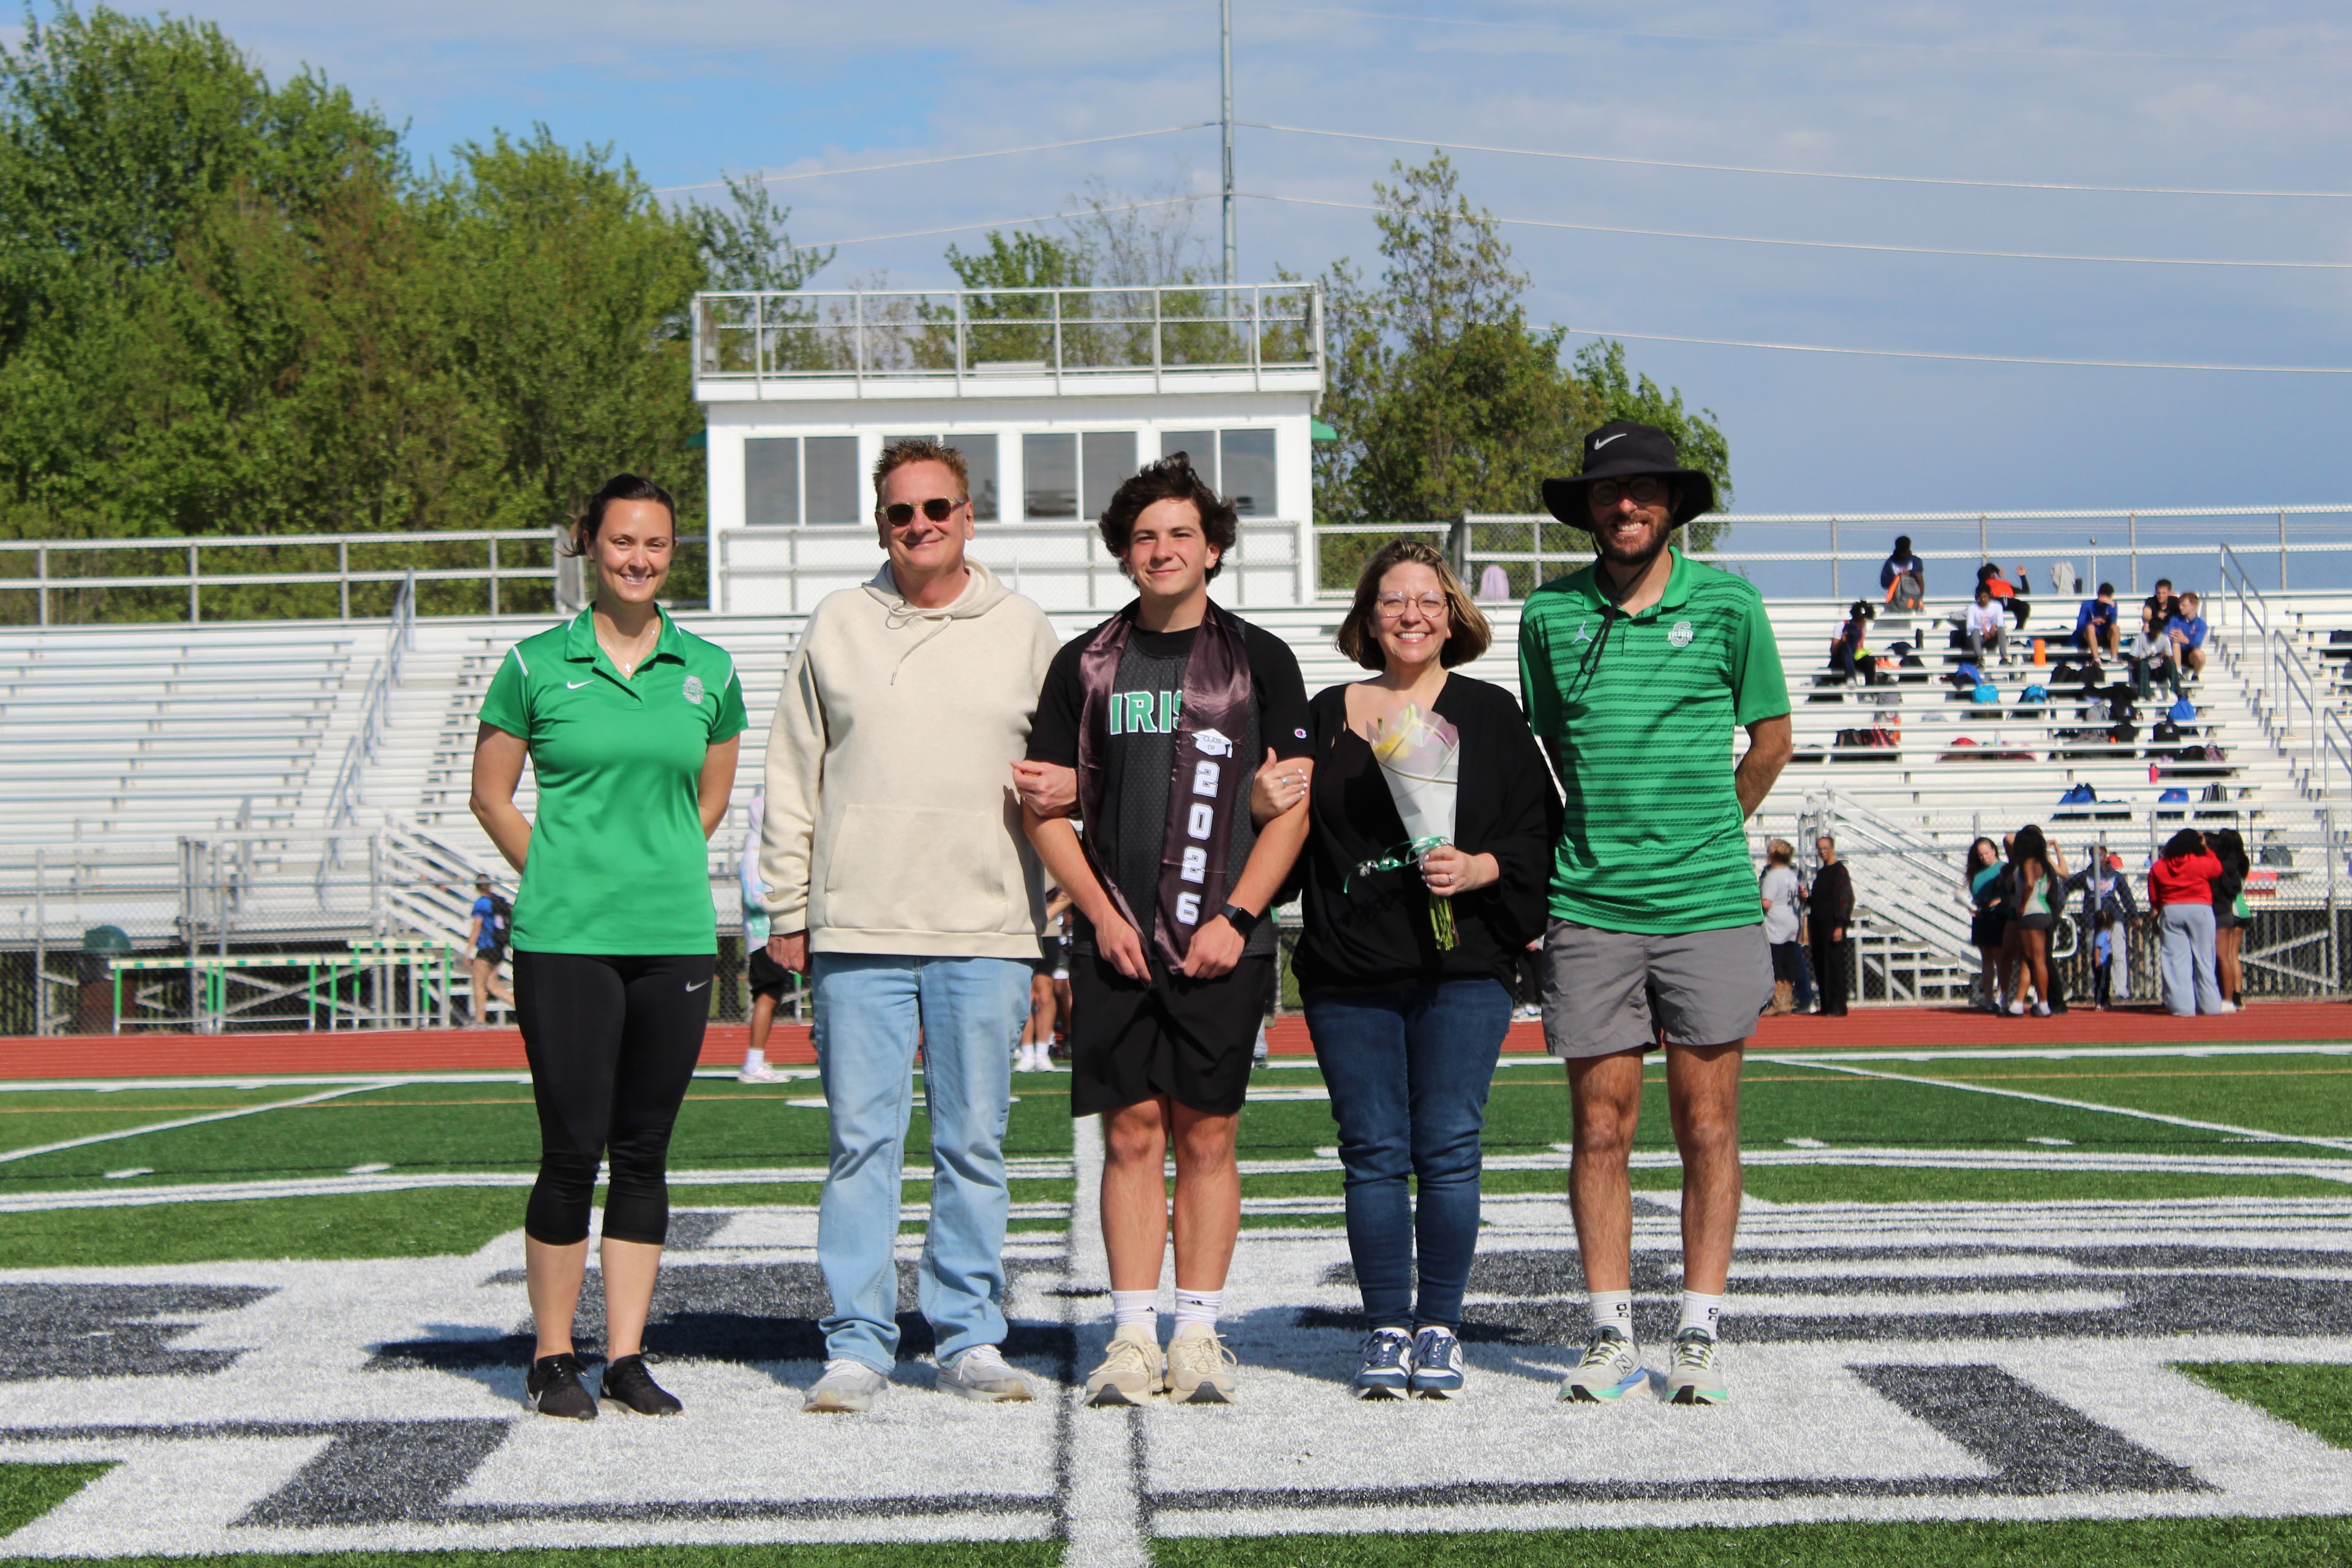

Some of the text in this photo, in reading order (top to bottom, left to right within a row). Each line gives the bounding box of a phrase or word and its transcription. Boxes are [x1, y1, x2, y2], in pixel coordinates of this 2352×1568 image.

[1667, 631, 1694, 641] IRISH
[1203, 735, 1222, 745] CLASS
[1176, 760, 1221, 926] 2026
